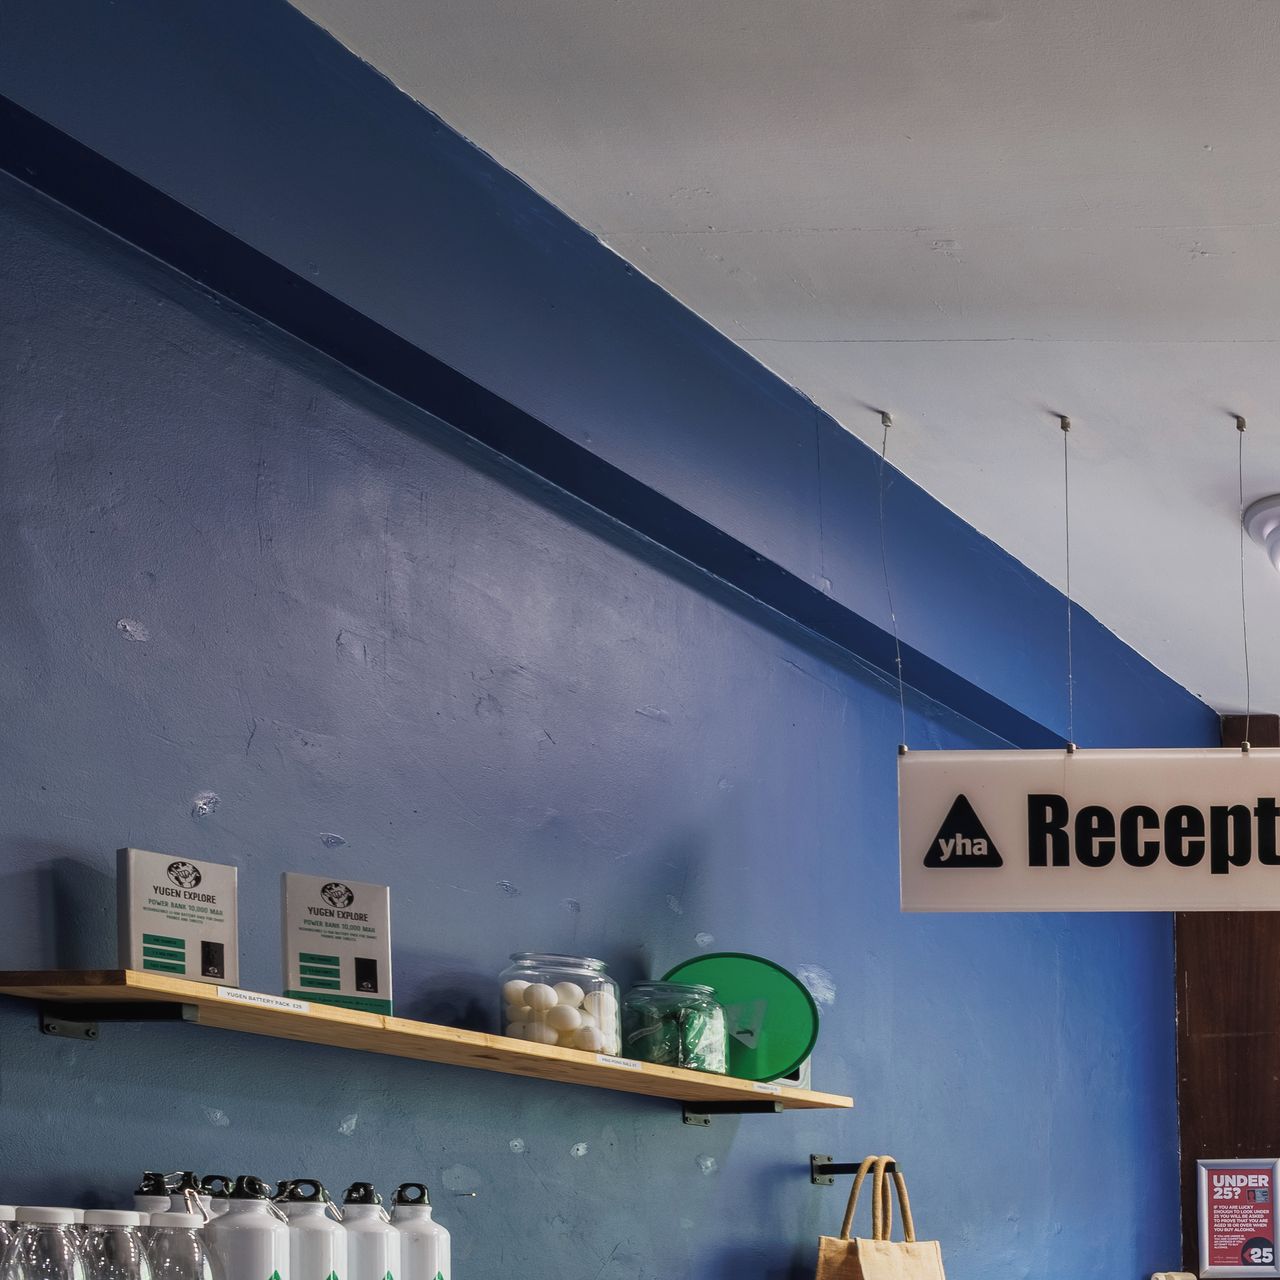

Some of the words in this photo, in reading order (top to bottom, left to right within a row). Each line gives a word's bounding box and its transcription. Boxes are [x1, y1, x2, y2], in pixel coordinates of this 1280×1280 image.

[938, 831, 989, 862] yha
[153, 884, 181, 899] YUGEN
[183, 890, 217, 905] EXPLORE
[226, 990, 248, 1002] YUGEN
[248, 994, 275, 1007] BATTERY
[275, 1000, 291, 1009] PACK
[1213, 1174, 1269, 1187] UNDER
[1213, 1187, 1242, 1200] 25?
[1250, 1247, 1274, 1263] 25
